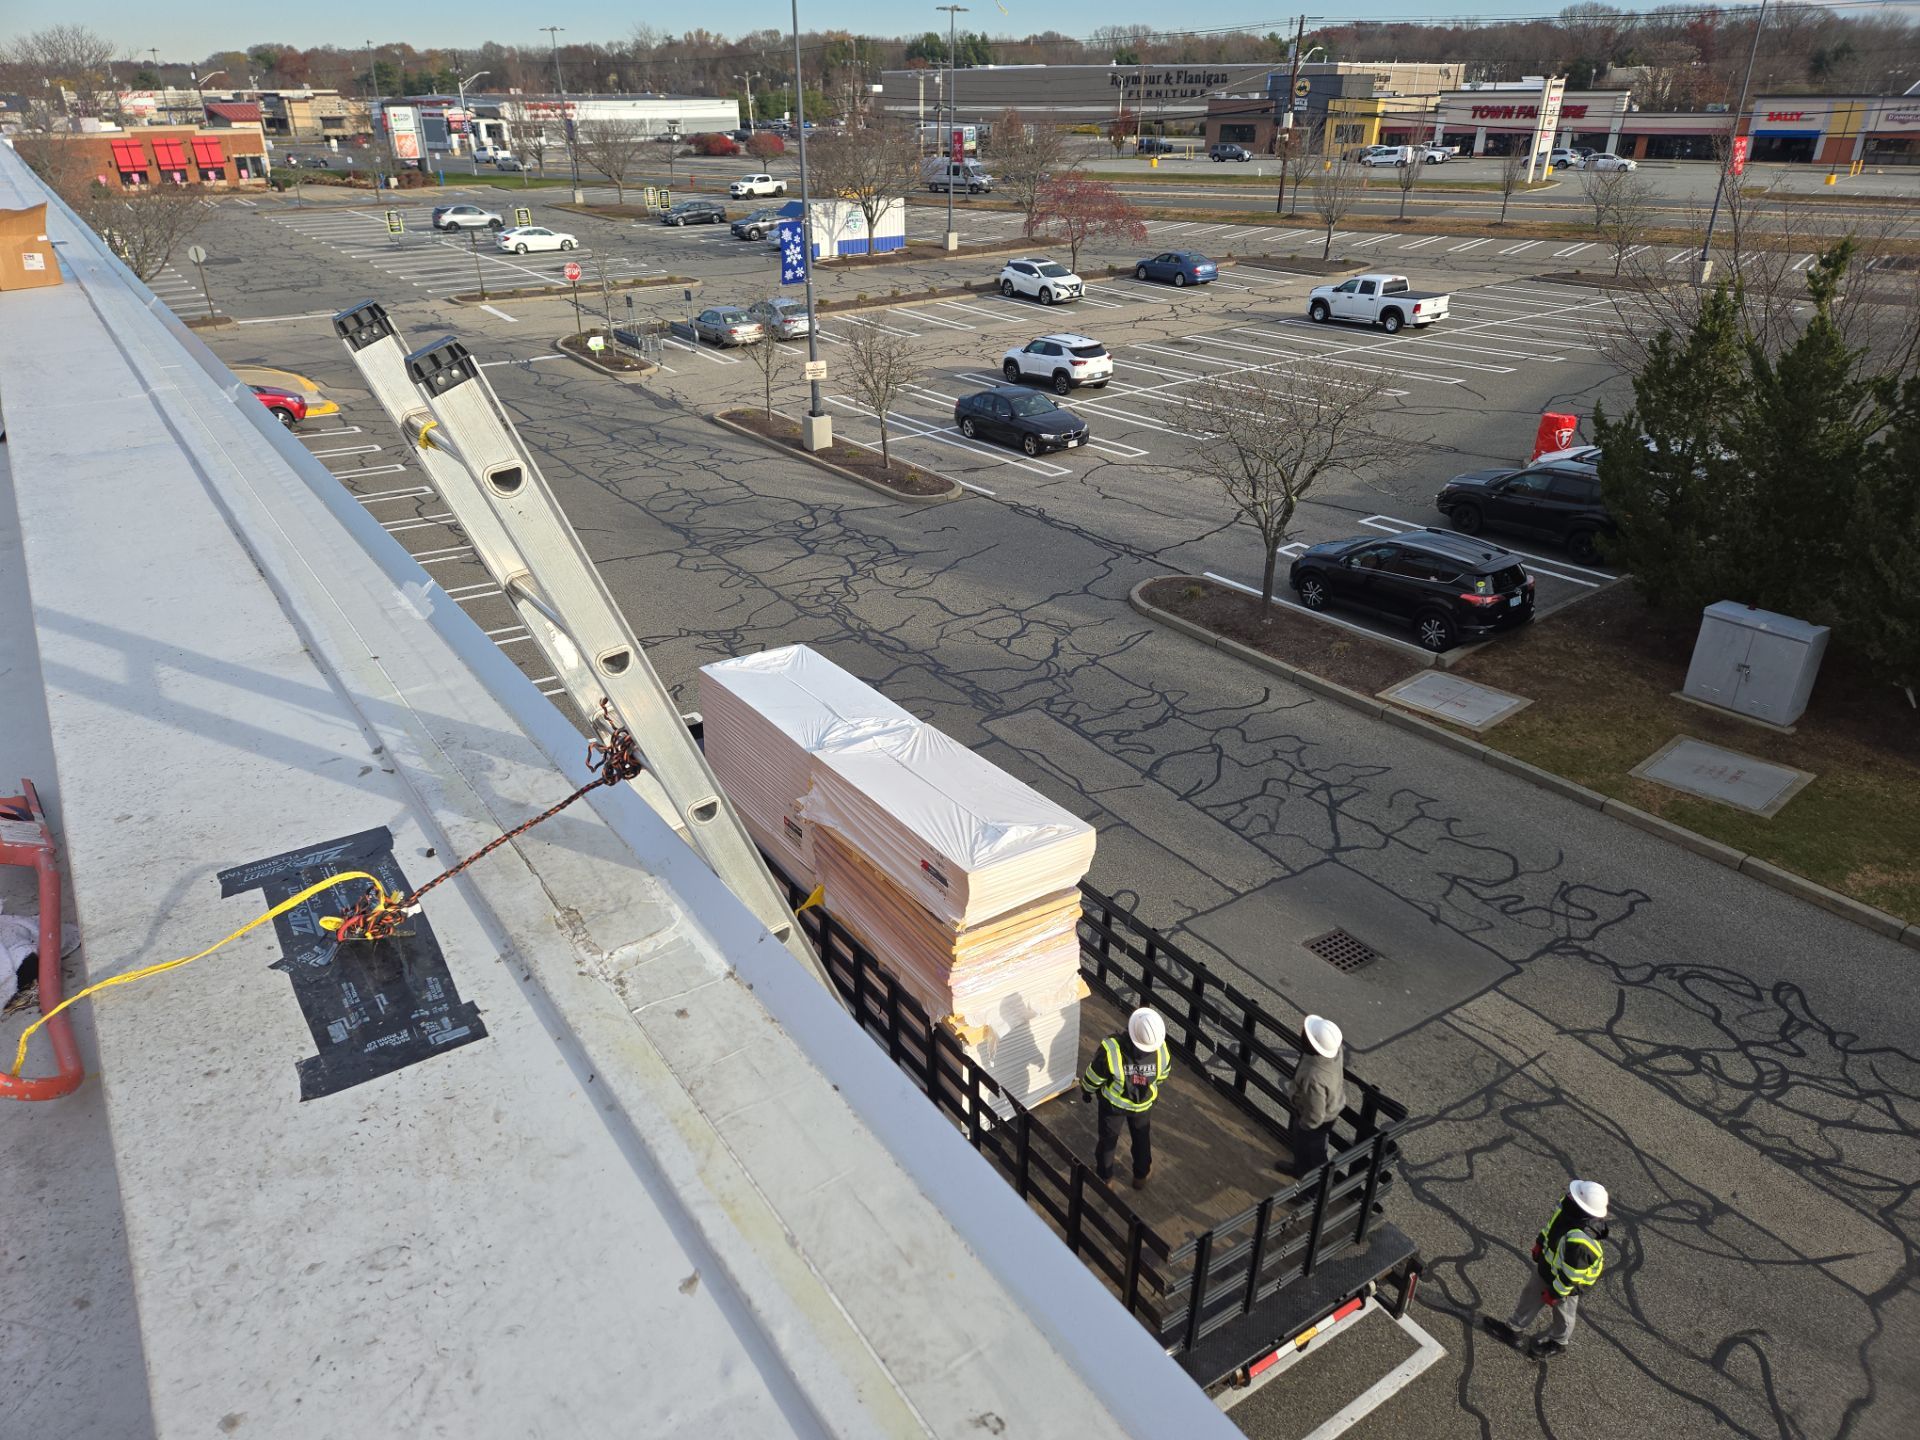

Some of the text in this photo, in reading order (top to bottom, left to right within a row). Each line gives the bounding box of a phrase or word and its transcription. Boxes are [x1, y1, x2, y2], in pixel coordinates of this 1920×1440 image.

[1163, 71, 1173, 86] &
[1175, 70, 1228, 87] Flanigan
[1128, 89, 1208, 98] FURNITURE
[1471, 105, 1515, 119] TOWN
[1515, 105, 1540, 119] FAI
[1767, 111, 1804, 121] SALLY
[564, 267, 581, 275] STOP
